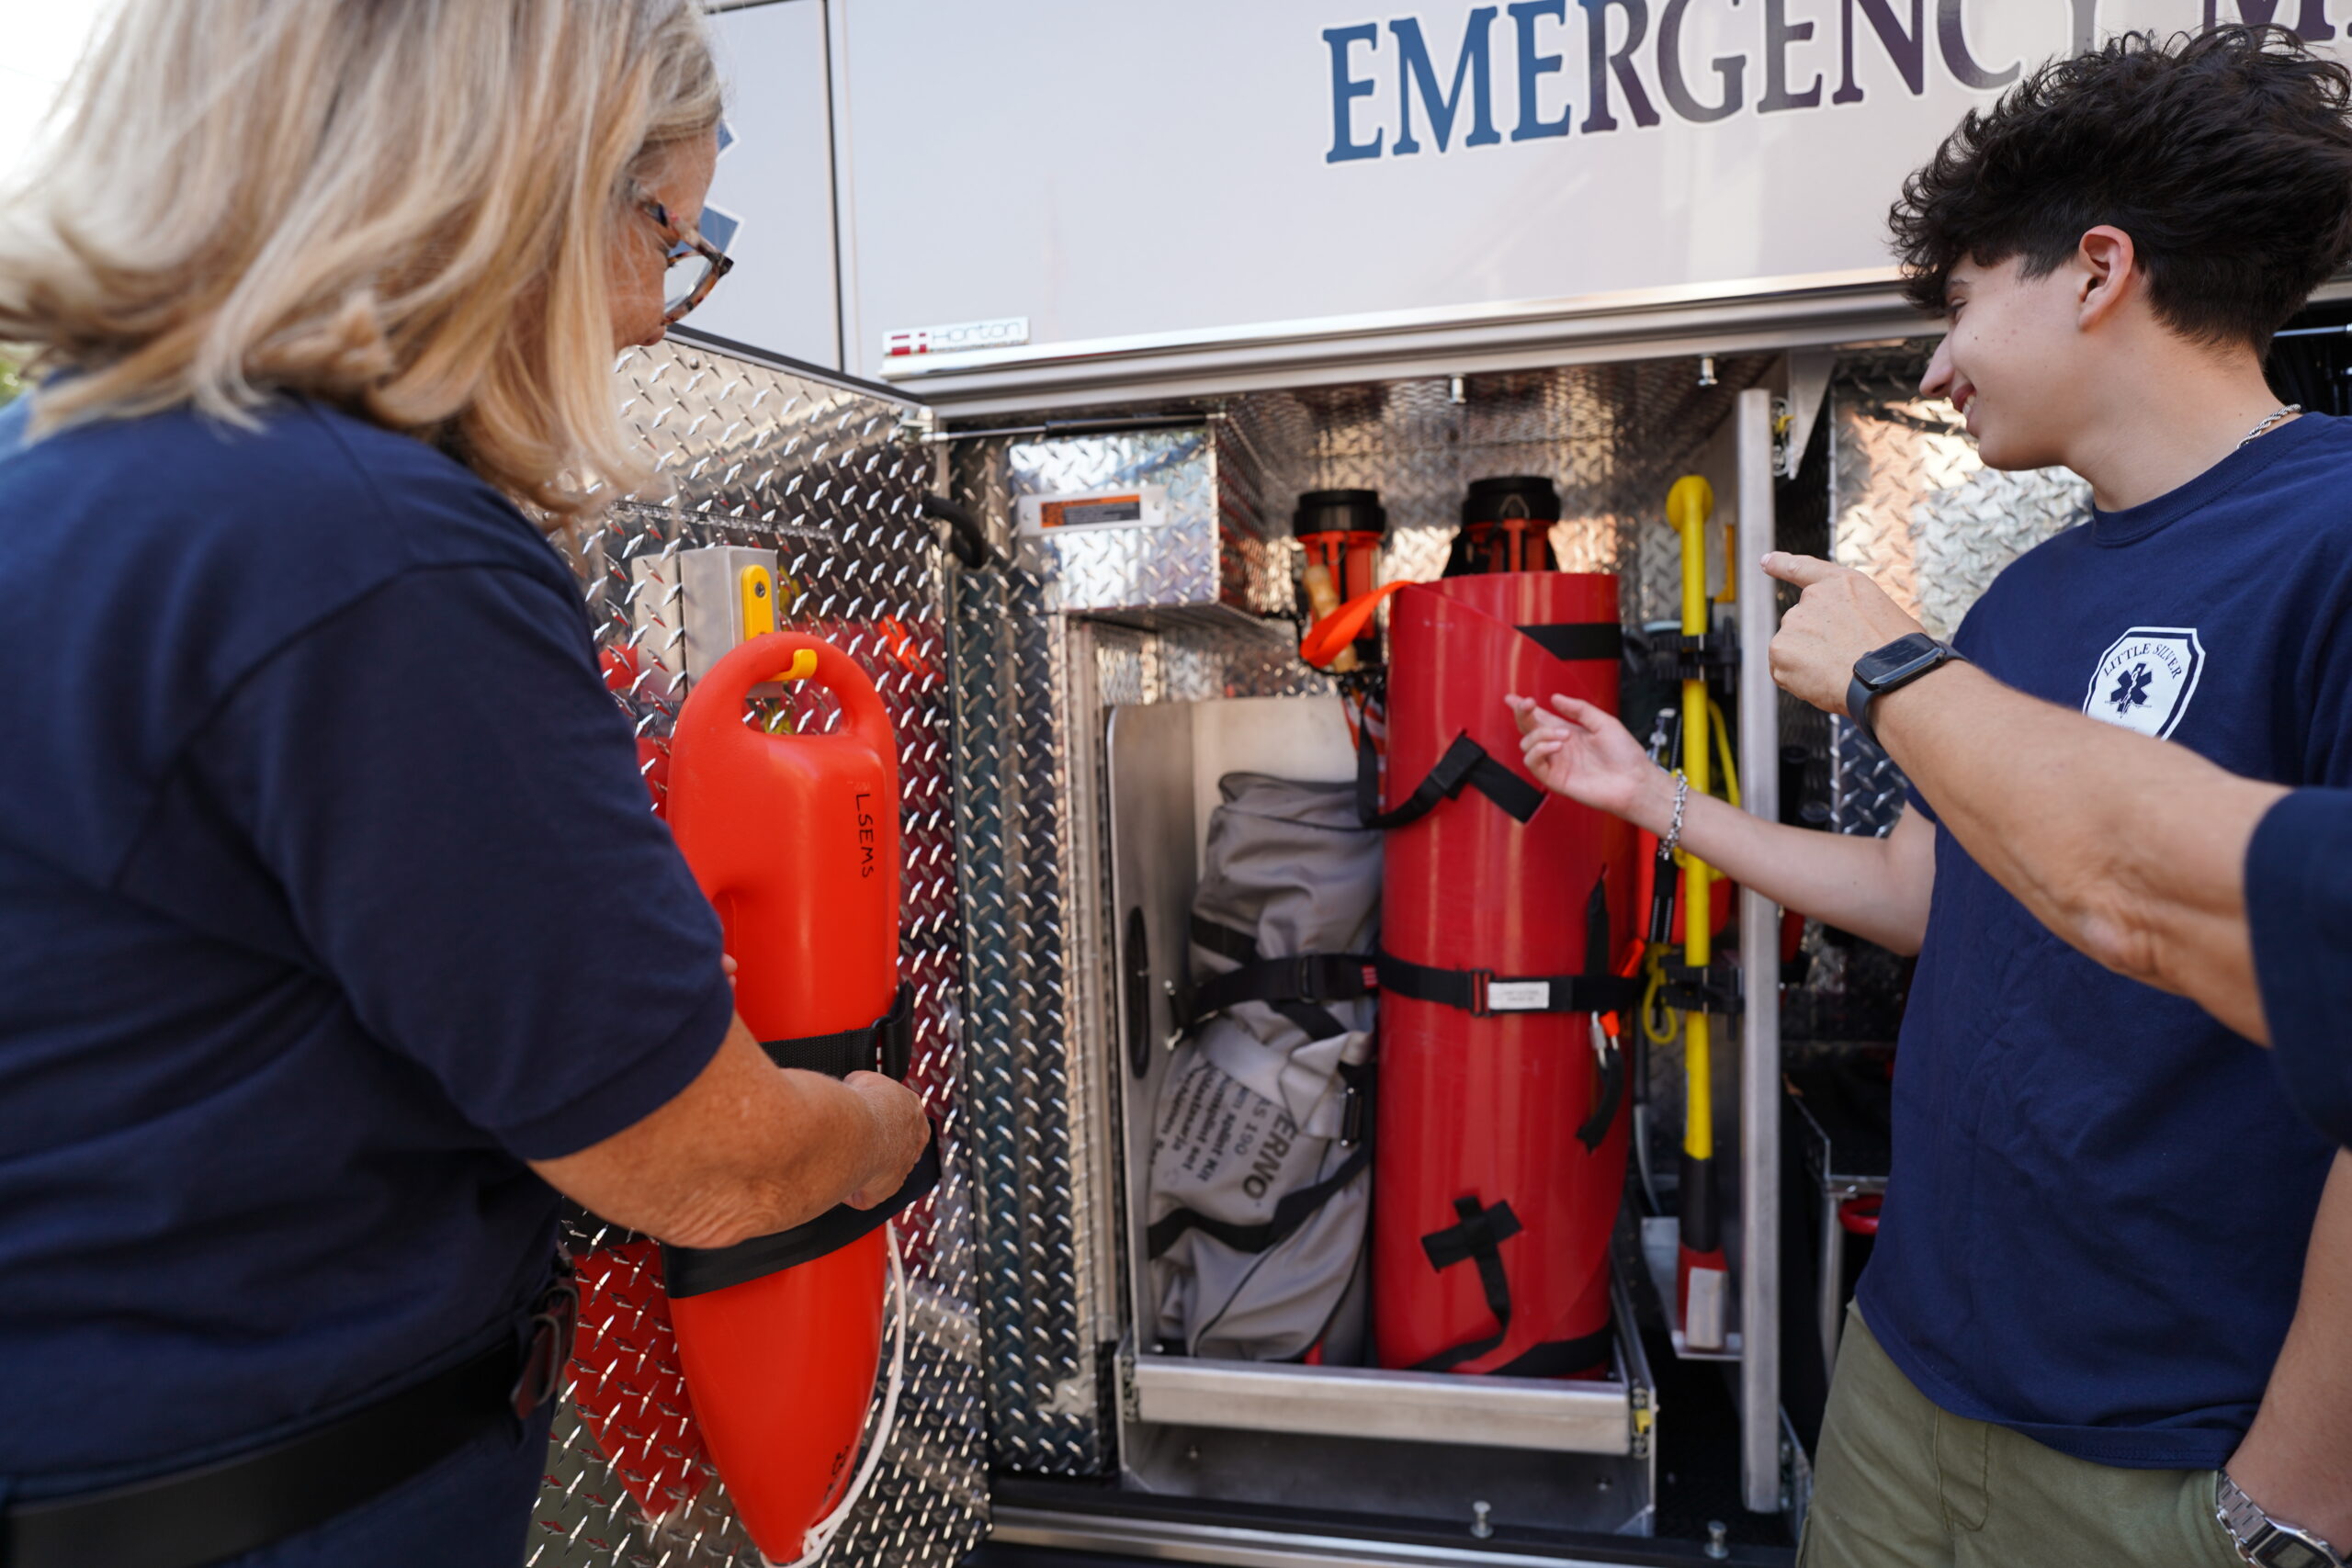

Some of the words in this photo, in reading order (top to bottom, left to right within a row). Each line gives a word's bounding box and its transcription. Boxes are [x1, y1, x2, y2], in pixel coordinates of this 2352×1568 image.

[932, 321, 1022, 344] Horton
[2104, 643, 2151, 676] LITTLE
[2153, 644, 2182, 680] SILVER
[855, 793, 874, 878] LSEMS
[1243, 1111, 1298, 1200] ERNO
